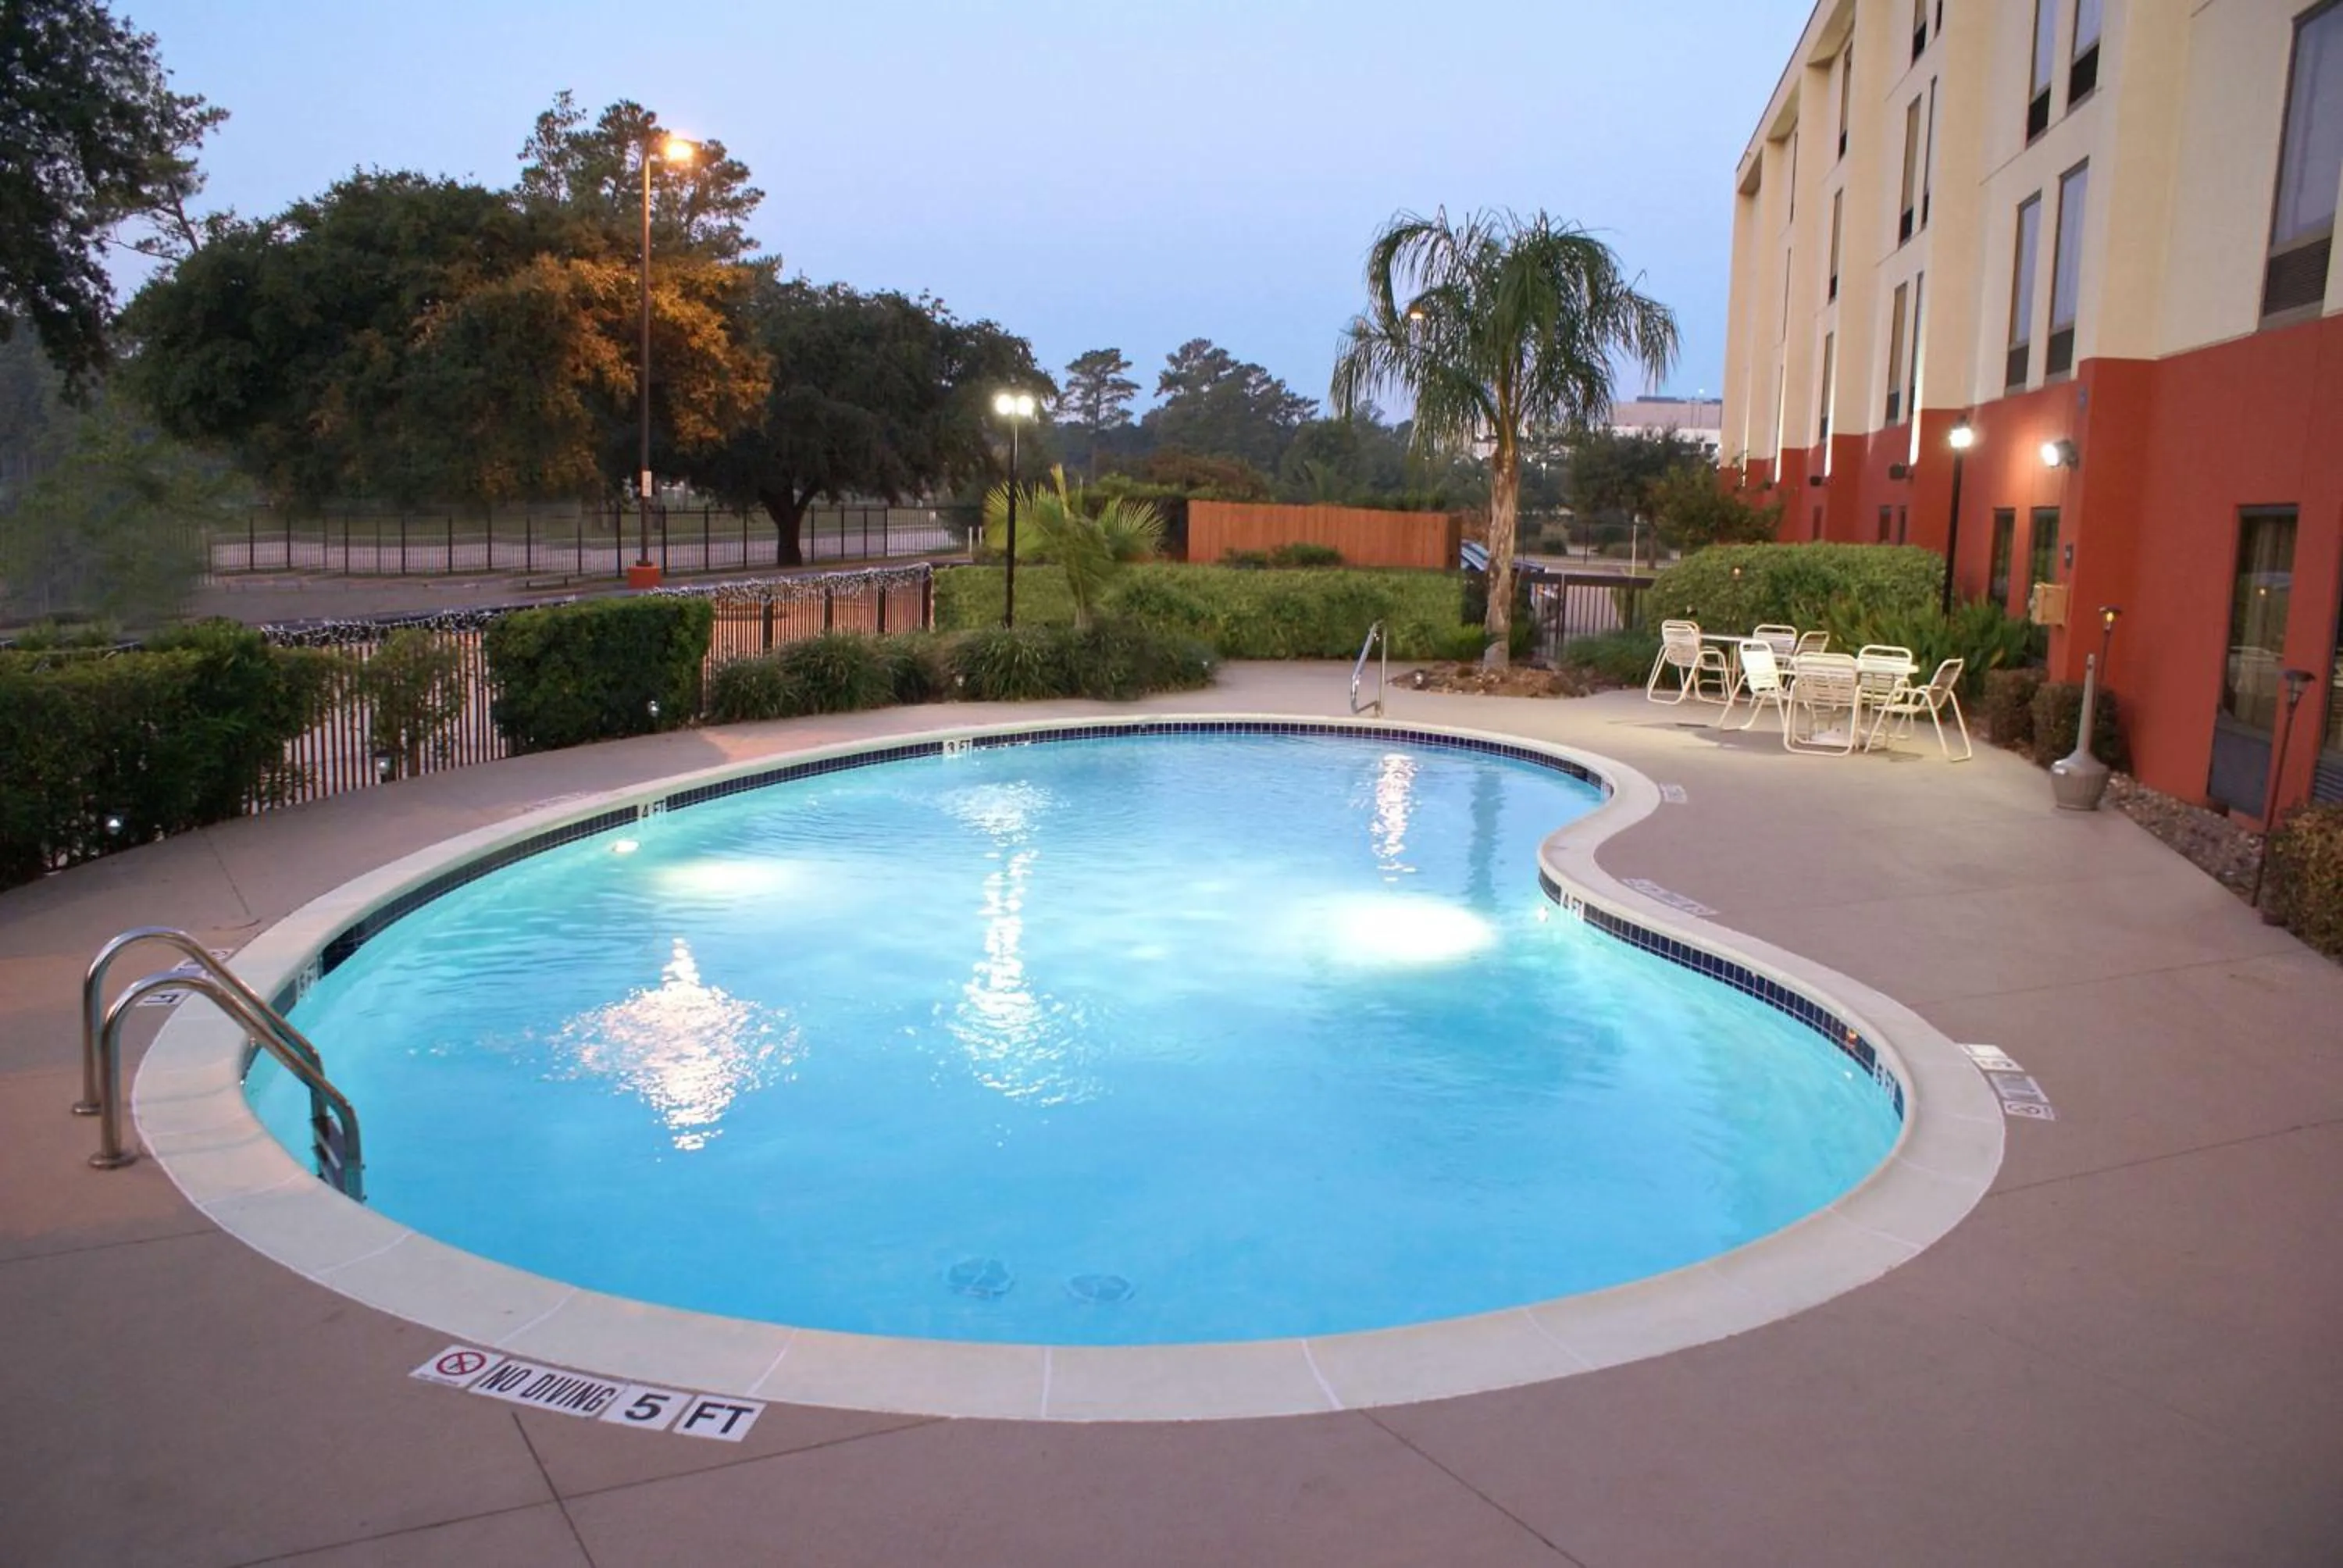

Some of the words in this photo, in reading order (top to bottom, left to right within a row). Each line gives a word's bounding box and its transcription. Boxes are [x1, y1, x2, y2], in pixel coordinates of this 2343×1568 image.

[642, 804, 648, 818] 4
[653, 799, 665, 814] FT
[479, 1363, 532, 1392] NO
[519, 1373, 615, 1413] DIVING
[624, 1393, 670, 1421] 5
[683, 1401, 754, 1435] FT
